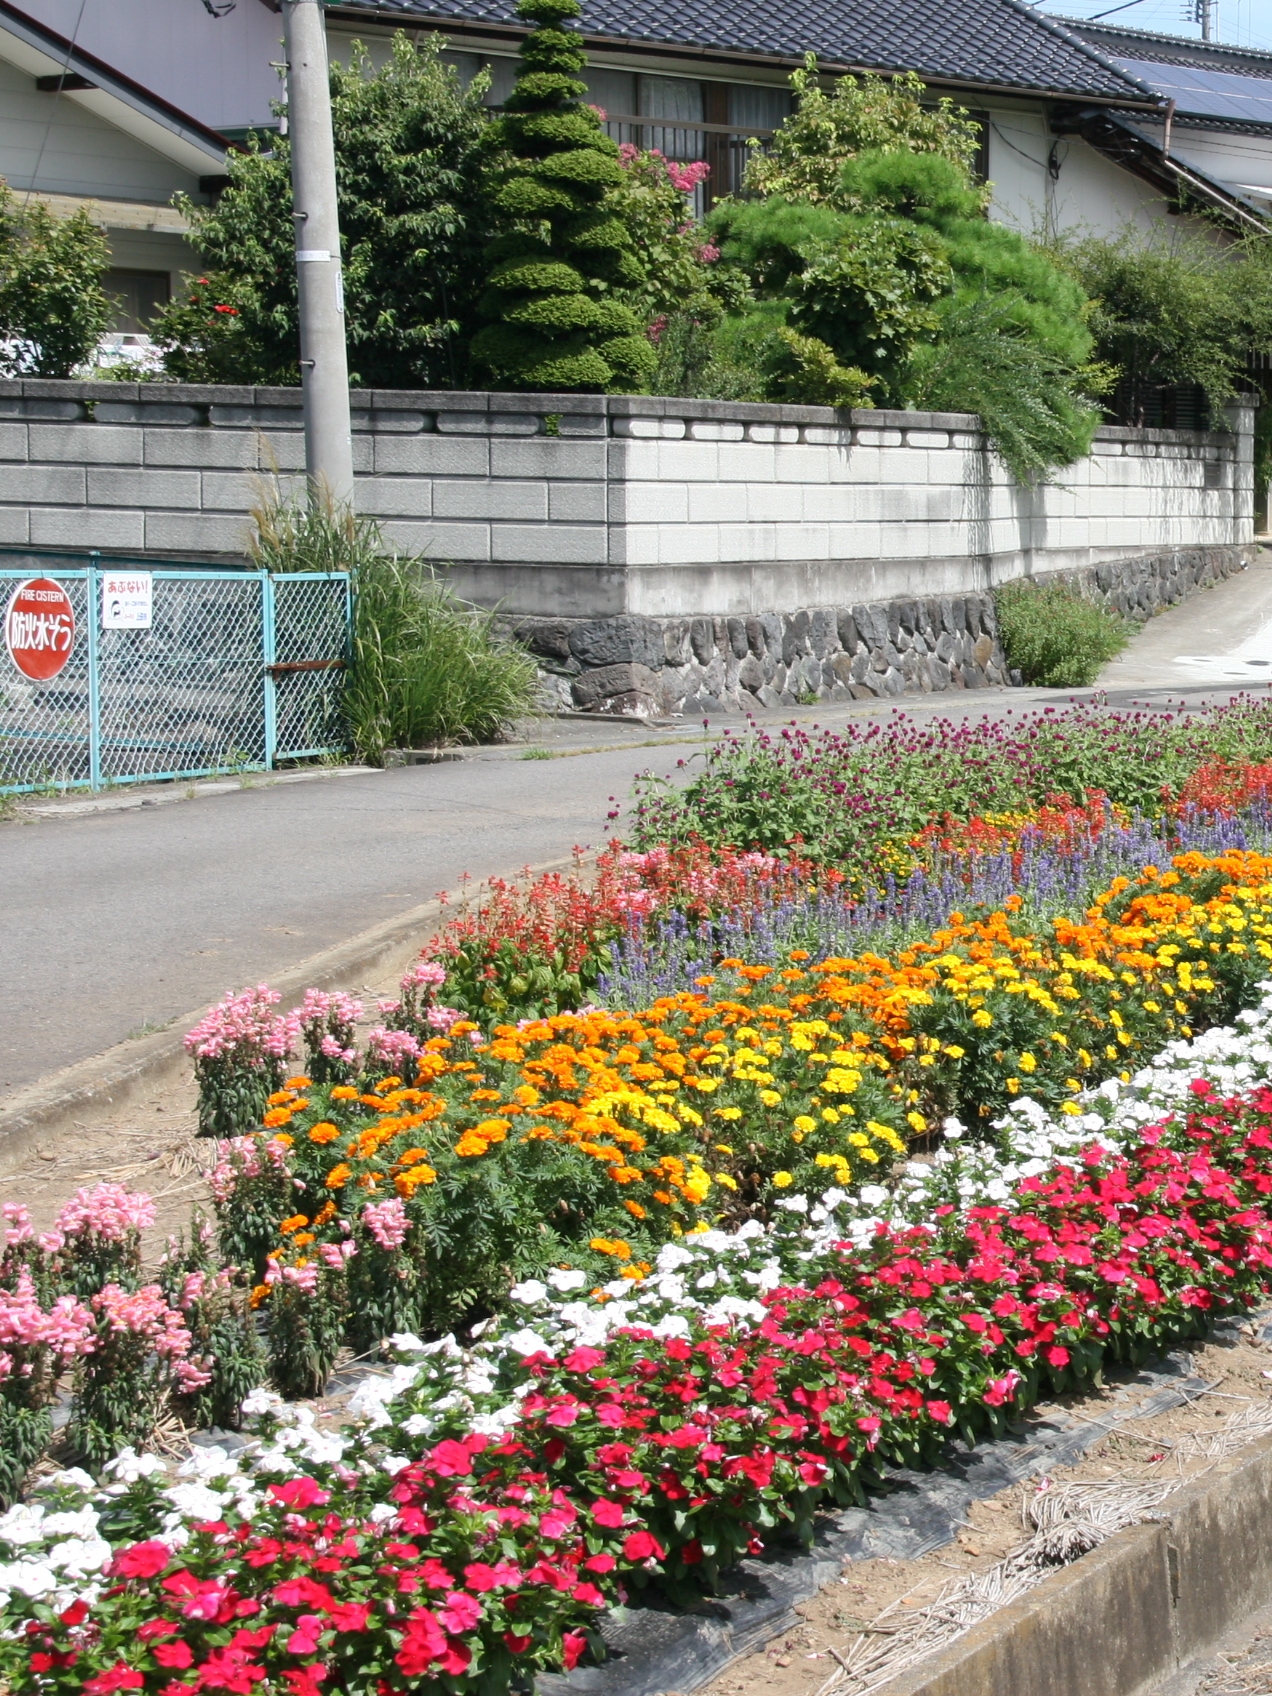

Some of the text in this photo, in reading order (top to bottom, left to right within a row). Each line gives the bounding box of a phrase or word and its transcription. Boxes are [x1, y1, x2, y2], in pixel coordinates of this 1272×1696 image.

[20, 589, 65, 603] FIRE CISTERN
[11, 611, 72, 652] 防火水そう
